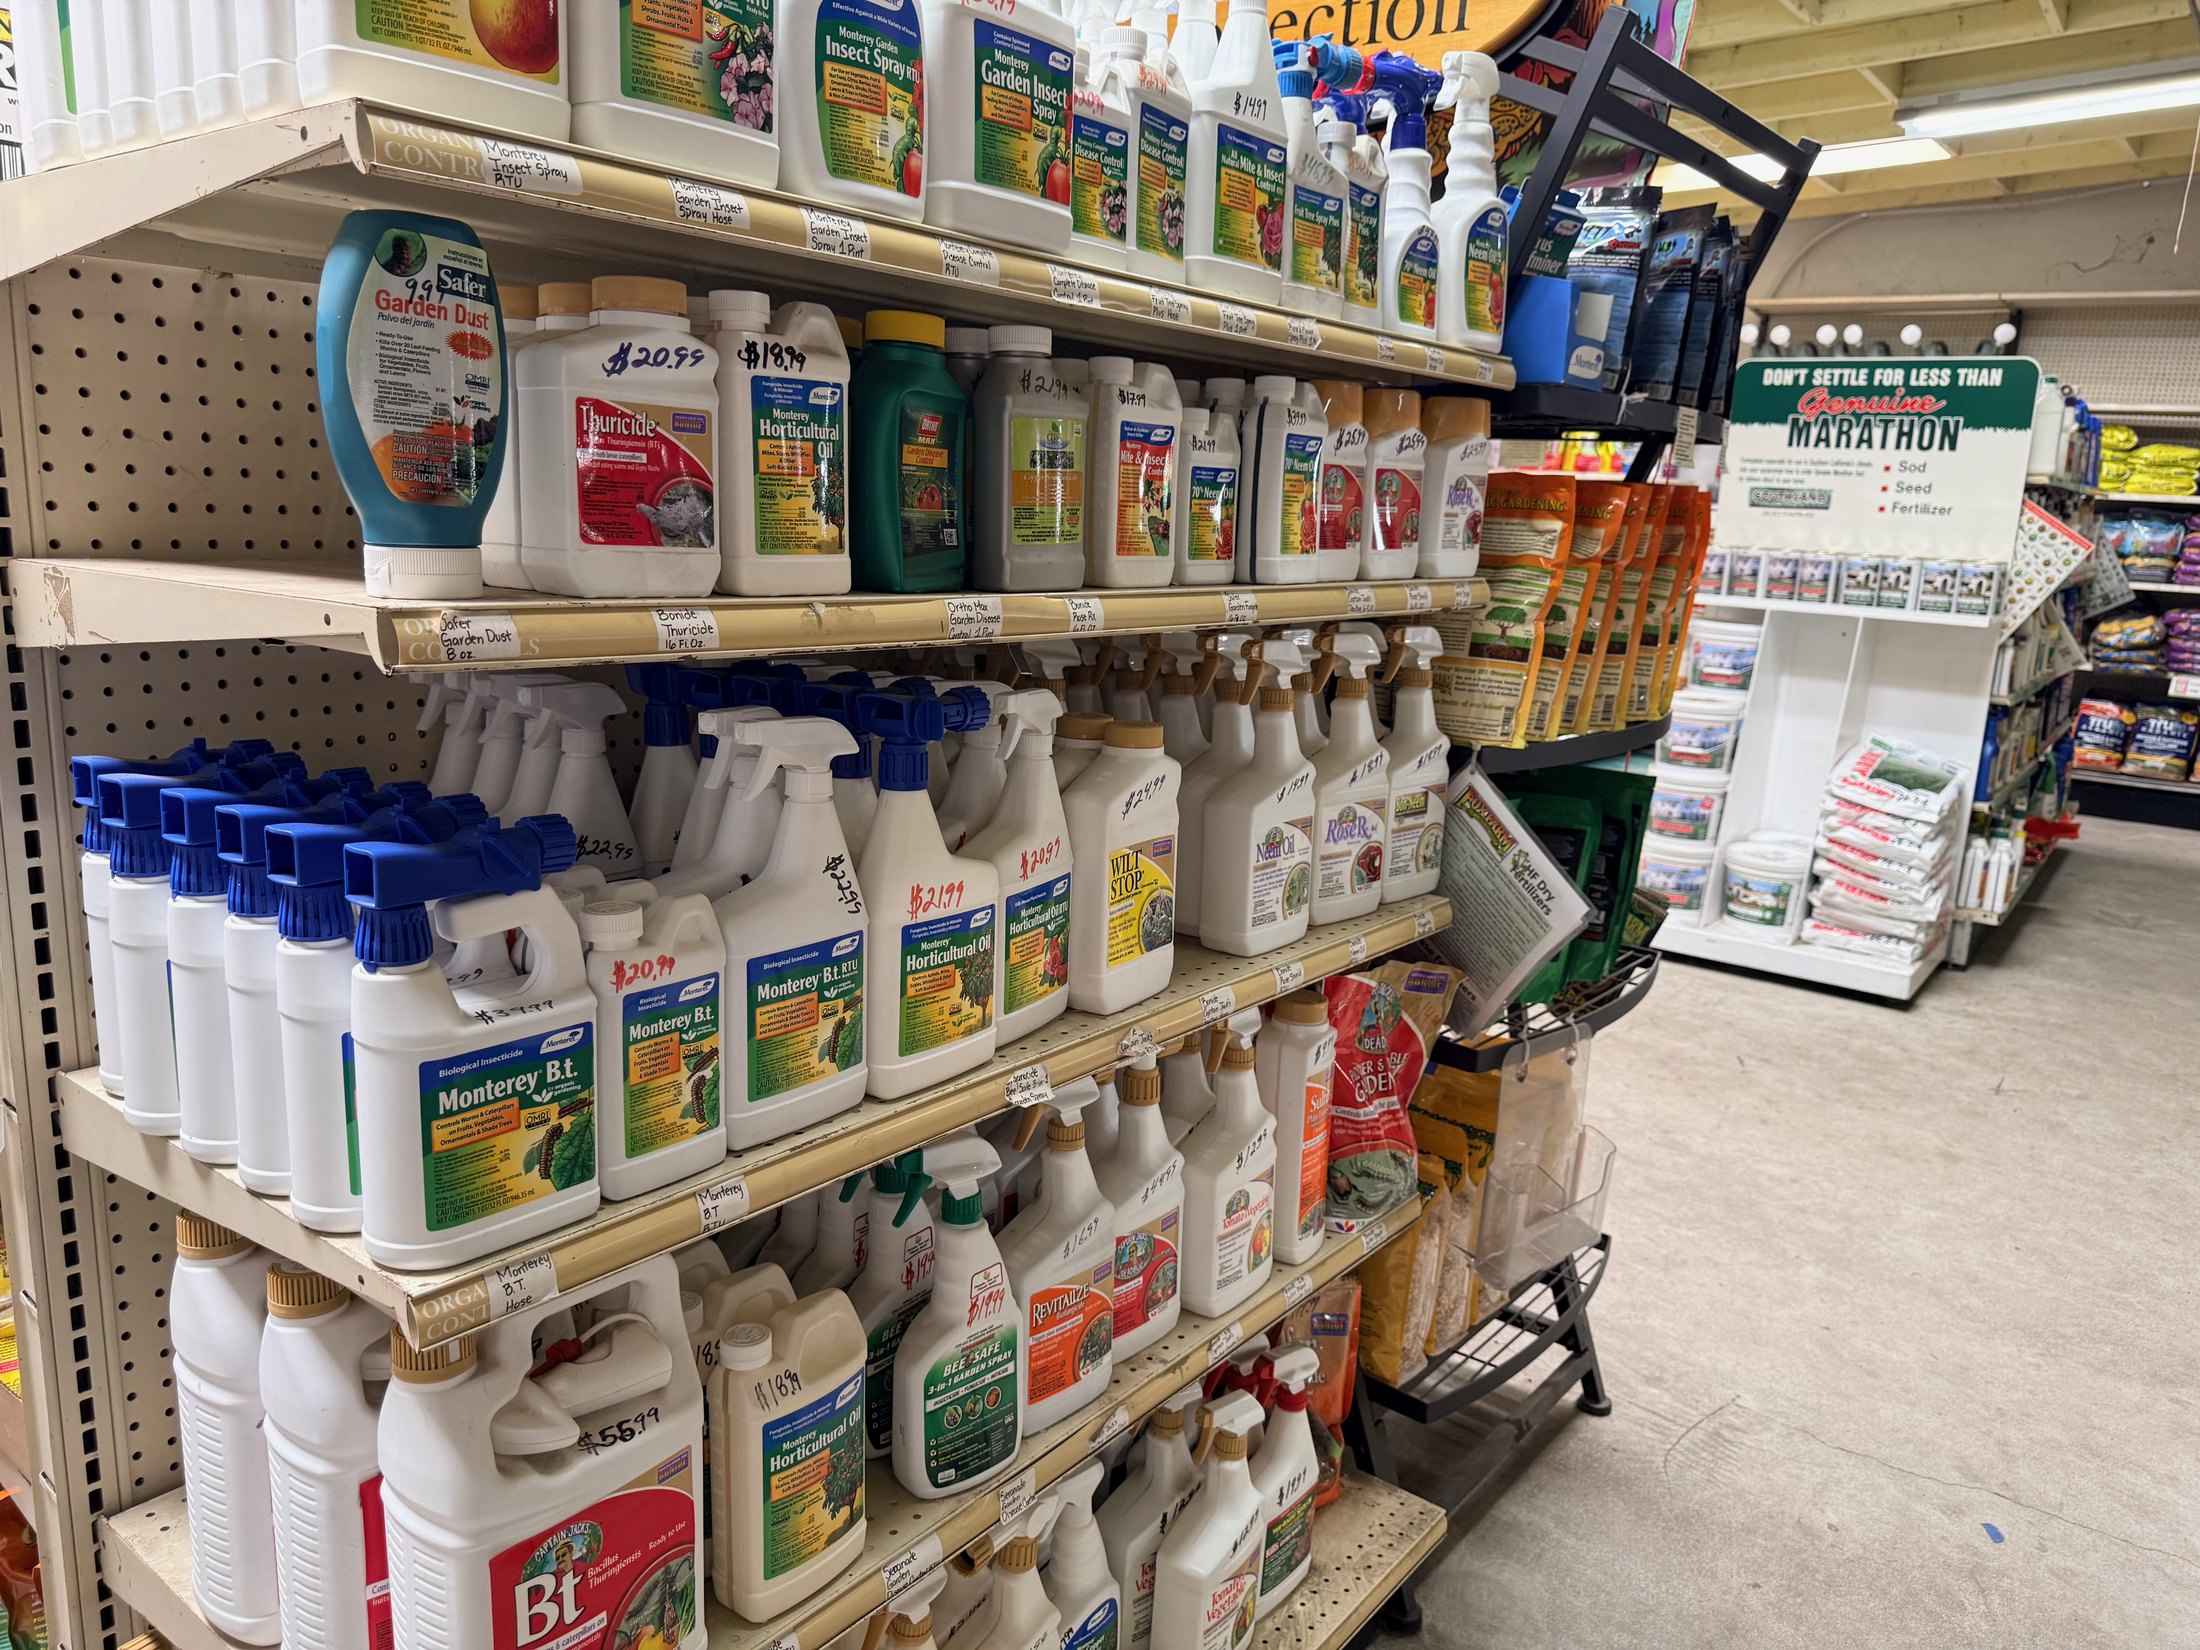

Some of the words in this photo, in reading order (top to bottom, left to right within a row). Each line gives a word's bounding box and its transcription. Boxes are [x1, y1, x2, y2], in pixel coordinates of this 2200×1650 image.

[372, 15, 404, 30] CAUTION
[1270, 0, 1469, 47] ection
[839, 25, 874, 47] Monterey
[875, 36, 898, 54] Garden
[825, 35, 869, 64] Insect
[873, 49, 905, 81] Spray
[906, 66, 920, 84] RTU
[994, 49, 1030, 74] Monterey
[982, 60, 1030, 95] Garden
[1033, 75, 1068, 109] Insect
[1033, 99, 1056, 124] Spray
[1233, 91, 1267, 121] $14.99
[378, 116, 481, 153] ORGAN
[385, 140, 486, 179] CONTR
[483, 138, 550, 168] Monterey
[1075, 145, 1099, 162] Disease
[1100, 151, 1123, 169] Control
[1141, 138, 1161, 157] Disease
[1162, 149, 1184, 168] Control
[489, 156, 532, 176] Insect
[535, 163, 569, 183] Spray
[1240, 158, 1256, 174] Mite
[1256, 166, 1263, 176] &
[1263, 168, 1285, 183] Insect
[670, 176, 721, 200] Monterey
[675, 191, 711, 210] Garden
[713, 198, 743, 215] Insect
[679, 205, 708, 221] Spray
[712, 210, 733, 225] Hose
[805, 208, 852, 229] Monterey
[810, 224, 842, 238] Garden
[843, 229, 868, 243] Insect
[811, 236, 836, 254] Spray
[439, 268, 487, 298] Safer
[374, 288, 448, 322] Garden
[454, 303, 489, 332] Dust
[377, 312, 397, 324] Polvo
[399, 316, 411, 327] del
[602, 342, 706, 378] $20.99
[738, 340, 807, 372] $18.99
[1762, 368, 1808, 386] DON'T
[1812, 368, 1869, 386] SETTLE
[1874, 368, 1905, 386] FOR
[1909, 368, 1951, 386] LESS
[1957, 368, 2003, 387] THAN
[1117, 388, 1146, 407] $17.99
[1798, 387, 1947, 421] Genuine
[580, 402, 657, 438] Thuricide
[772, 408, 810, 423] Monterey
[760, 418, 839, 441] Horticultural
[918, 436, 936, 445] MAX
[1787, 414, 1964, 452] MARATHON
[393, 442, 428, 456] CAUTION
[818, 442, 833, 459] Oil
[906, 447, 924, 456] Garden
[925, 449, 944, 459] Disease
[915, 456, 934, 465] Control
[392, 469, 442, 485] PRECAUCIÓN
[1898, 461, 1927, 474] Sod
[1895, 481, 1932, 495] Seed
[1500, 500, 1565, 512] GARDENING
[1892, 502, 1953, 516] Fertilizer
[657, 608, 698, 622] Bonide
[948, 602, 972, 613] Ortho
[974, 600, 988, 611] Max
[440, 612, 471, 631] Safer
[661, 622, 714, 637] Thuricide
[950, 614, 975, 626] Garden
[976, 613, 1000, 624] Disease
[441, 630, 485, 647] Garden
[486, 628, 512, 643] Dust
[665, 638, 676, 649] 16
[446, 648, 456, 661] 8
[1256, 843, 1281, 863] Neem
[1282, 834, 1295, 854] Oil
[1111, 850, 1142, 876] WILT
[1110, 872, 1143, 900] STOP
[1509, 866, 1552, 917] Fertilizers
[1538, 879, 1555, 901] Dry
[907, 880, 964, 920] $21.99
[1020, 904, 1043, 918] Monterey
[1010, 910, 1050, 936] Horticultural
[906, 942, 977, 972] Horticultural
[978, 934, 991, 950] Oil
[920, 938, 951, 951] Monterey
[763, 956, 791, 970] Biological
[791, 950, 819, 964] Insecticide
[609, 954, 677, 994] $20.99
[756, 975, 821, 1002] Monterey
[823, 967, 841, 984] B.t.
[841, 959, 858, 974] RTU
[638, 1000, 667, 1012] Insecticide
[639, 993, 667, 1005] Biological
[629, 1015, 692, 1042] Monterey
[693, 1006, 714, 1024] B.t.
[439, 1059, 480, 1078] Biological
[481, 1049, 523, 1066] Insecticide
[439, 1071, 540, 1115] Monterey
[546, 1058, 578, 1084] B.t.
[436, 1116, 460, 1131] Controls
[460, 1112, 478, 1123] Worms
[484, 1102, 515, 1117] Caterpillars
[526, 1110, 550, 1123] OMRI
[440, 1132, 475, 1146] Ornamentals
[697, 1184, 744, 1206] Monterey
[436, 1203, 463, 1217] CAUTION
[495, 1253, 552, 1283] Monterey
[505, 1294, 532, 1313] Hose
[967, 1287, 1005, 1328] $19.99
[1032, 1282, 1090, 1328] REVITALIZE
[944, 1360, 966, 1378] BEE
[973, 1341, 1001, 1363] SAFE
[953, 1363, 986, 1386] GARDEN
[987, 1351, 1012, 1370] SPRAY
[770, 1420, 847, 1473] Horticultural
[849, 1405, 861, 1426] Oil
[783, 1429, 817, 1452] Monterey
[534, 1530, 568, 1563] CAPTAIN
[649, 1532, 667, 1550] Ready
[668, 1527, 674, 1537] to
[675, 1520, 686, 1534] Use
[587, 1552, 619, 1579] Bacillus
[588, 1550, 642, 1589] Thuringiensis
[514, 1568, 585, 1648] Bt
